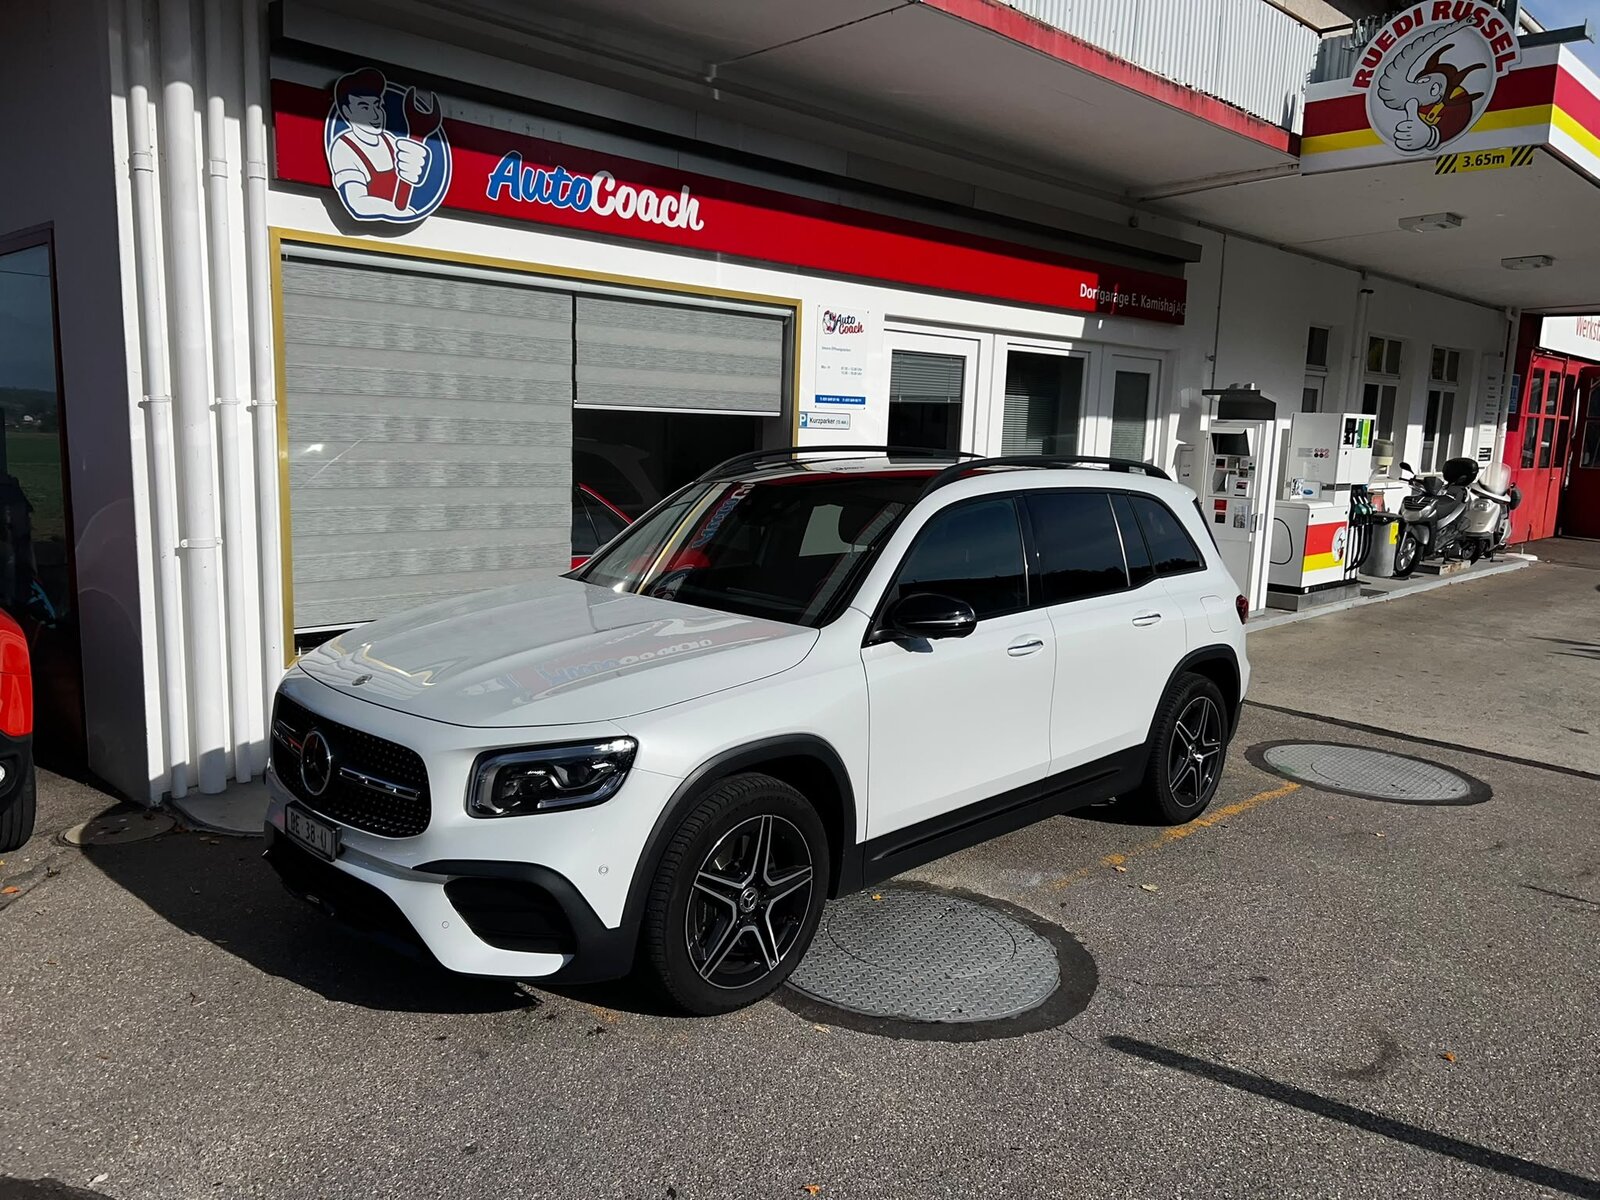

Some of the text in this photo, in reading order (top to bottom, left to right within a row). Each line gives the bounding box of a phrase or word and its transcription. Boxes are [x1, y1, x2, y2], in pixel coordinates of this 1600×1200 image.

[1352, 7, 1424, 89] RUEDI
[1462, 153, 1505, 168] 3.65m
[486, 150, 704, 231] AutoCoach
[1080, 283, 1129, 308] Dorfgarage
[1131, 293, 1139, 307] E.
[837, 314, 856, 325] Auto
[839, 322, 864, 335] Coach
[1575, 316, 1600, 342] Werkst
[809, 417, 835, 425] Kurzparker
